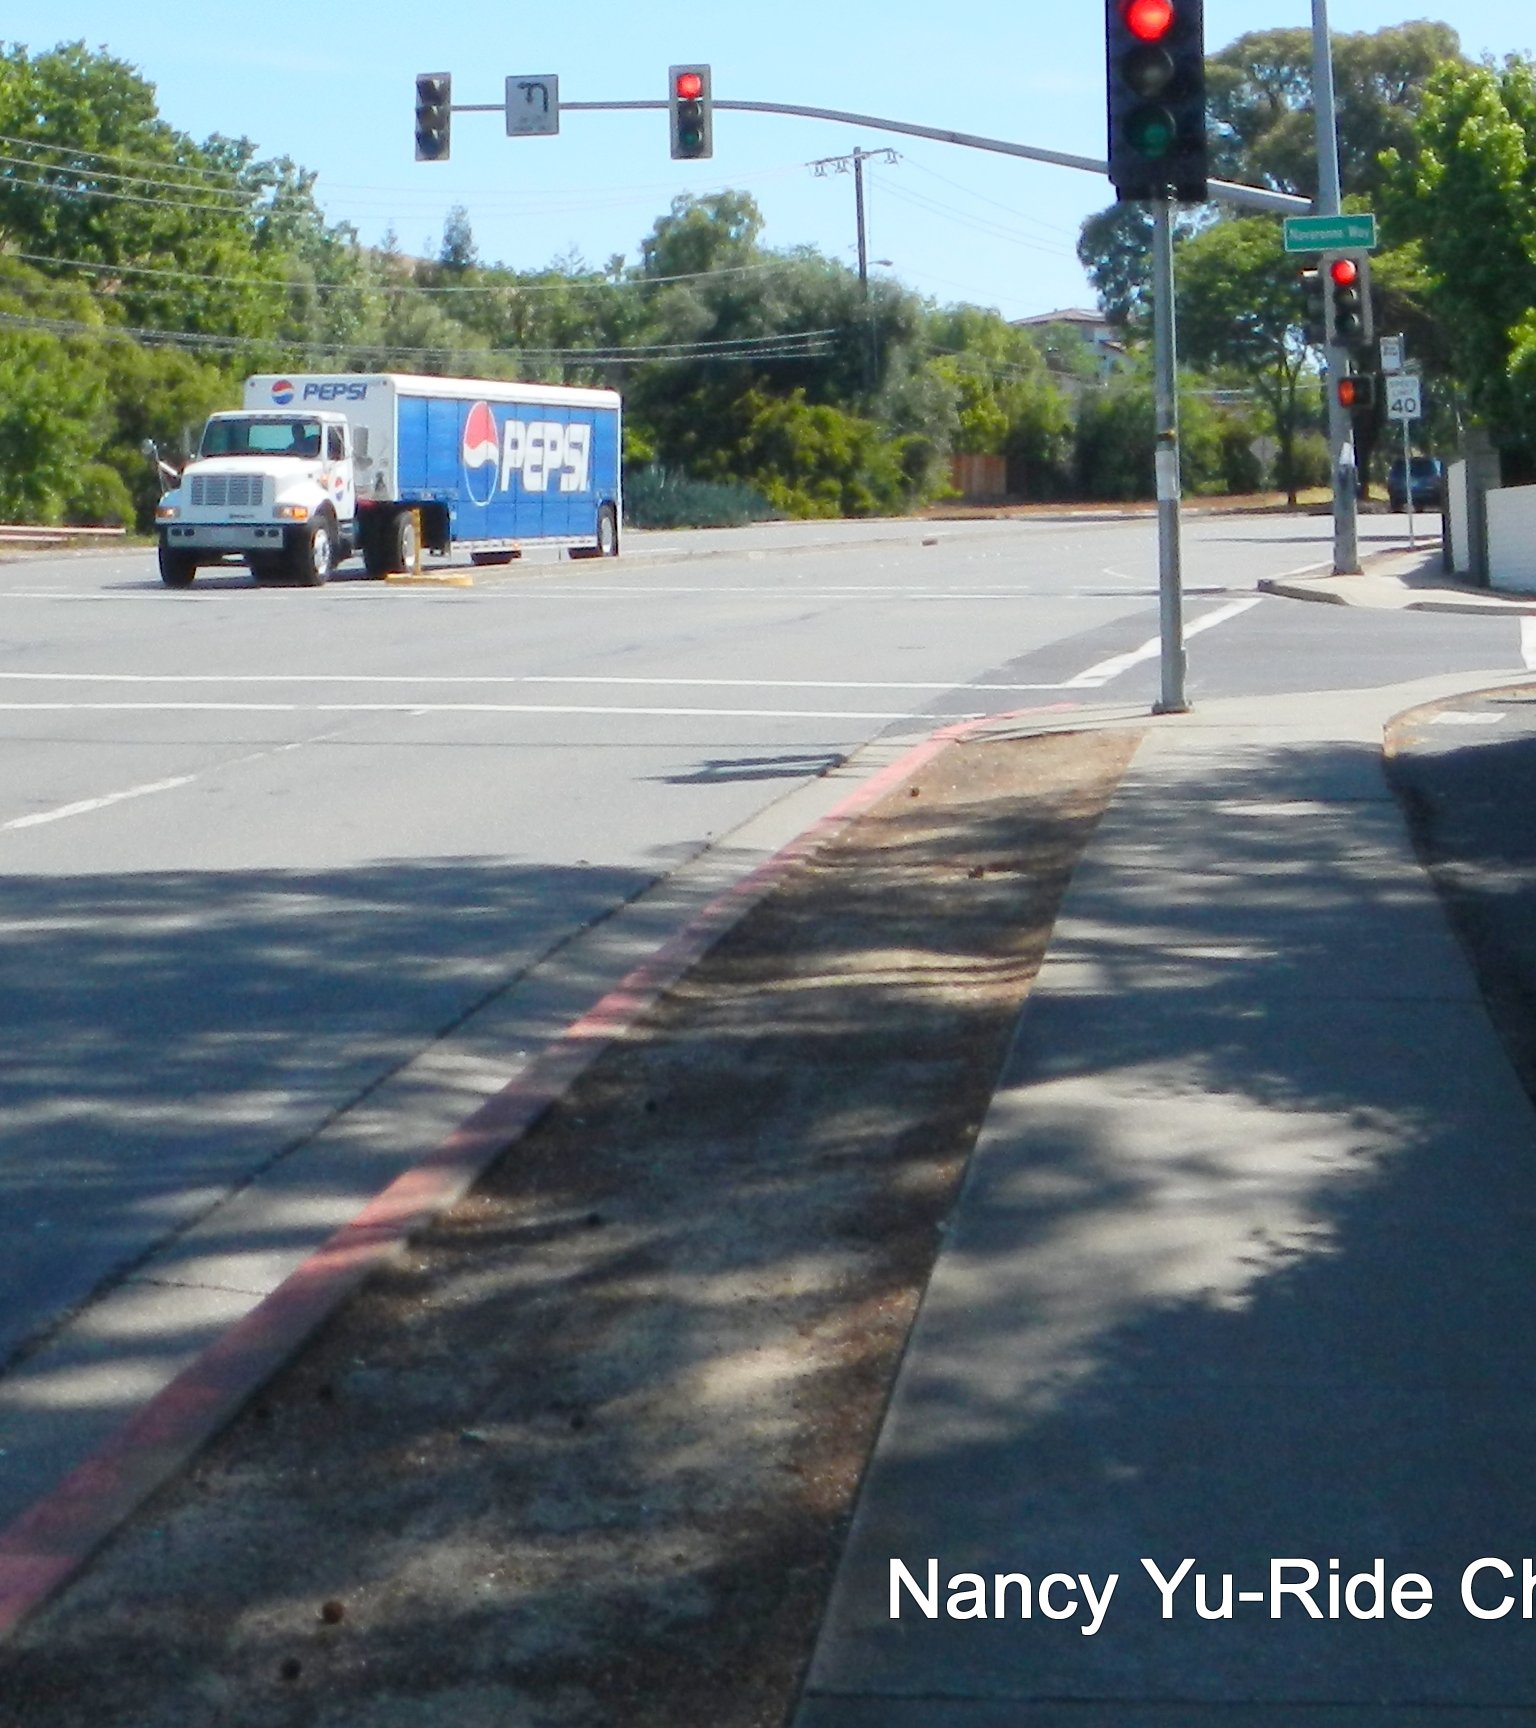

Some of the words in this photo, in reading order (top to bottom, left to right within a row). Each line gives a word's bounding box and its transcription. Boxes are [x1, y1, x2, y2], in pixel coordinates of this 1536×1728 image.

[303, 382, 368, 401] PEPSI
[1392, 398, 1416, 413] 40
[501, 419, 591, 492] PEPSI
